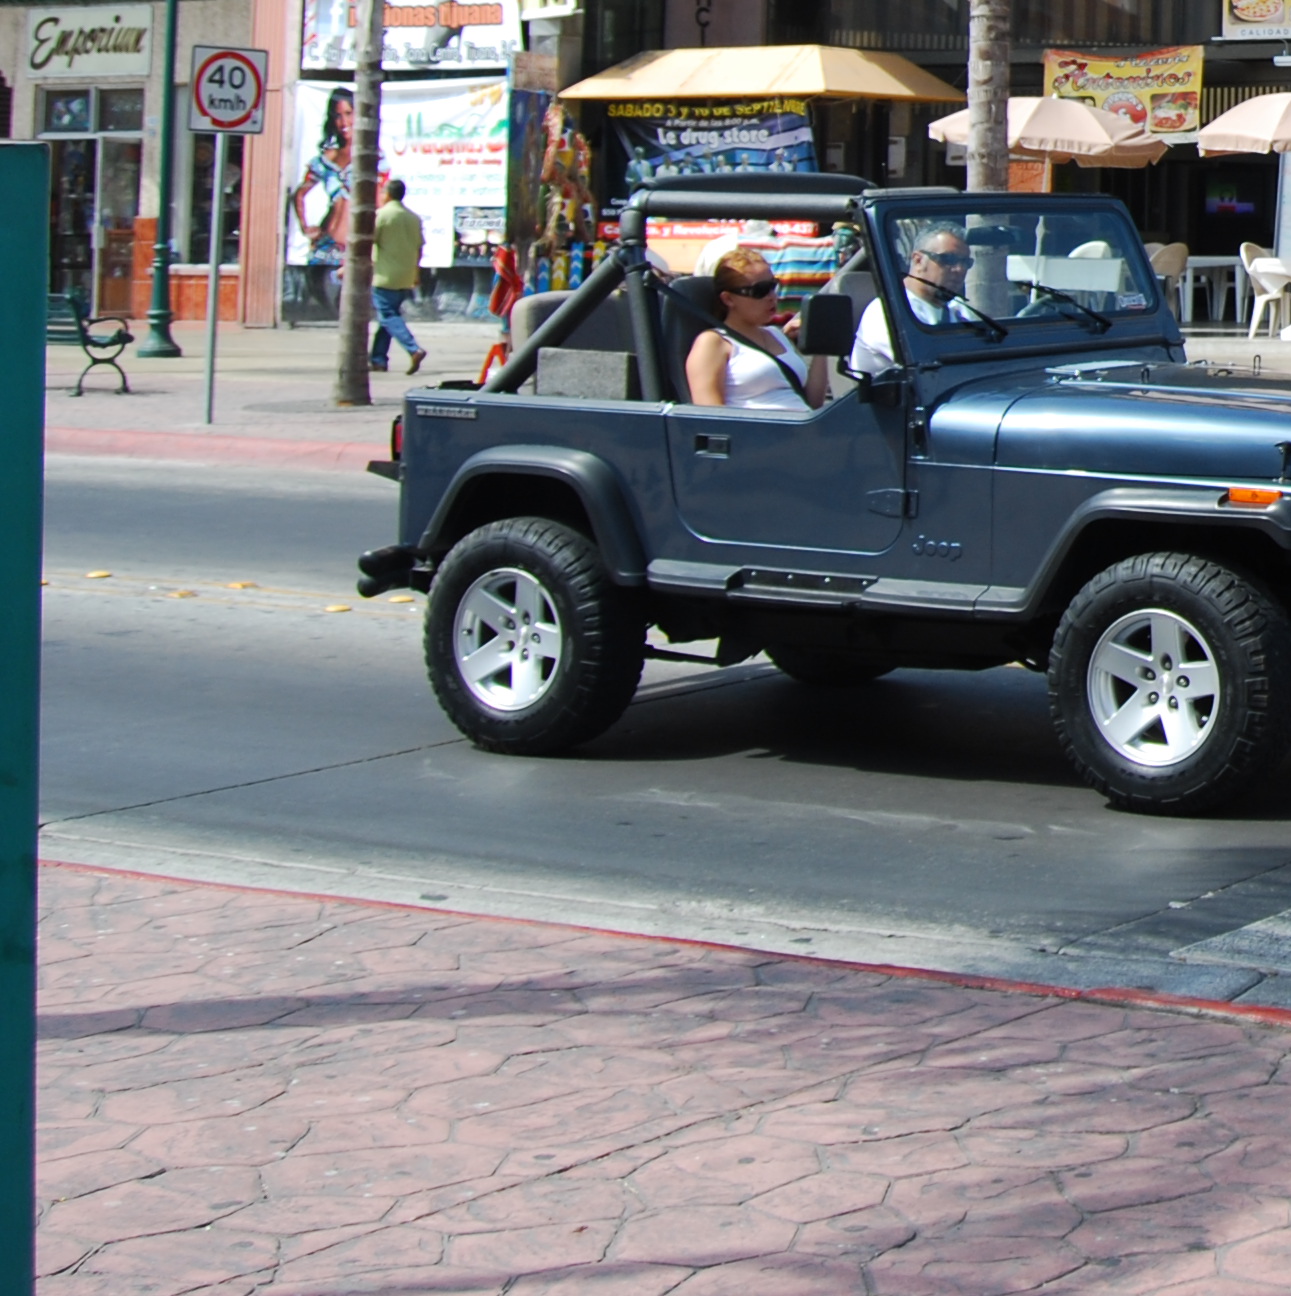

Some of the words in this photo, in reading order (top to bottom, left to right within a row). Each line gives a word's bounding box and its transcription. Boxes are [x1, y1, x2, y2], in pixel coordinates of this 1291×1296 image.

[438, 1, 503, 29] tijuana
[30, 15, 148, 70] Emporium
[206, 64, 247, 90] 40
[1052, 58, 1193, 91] Antoninos
[207, 93, 248, 112] km/h
[607, 103, 664, 117] SABADO
[679, 127, 719, 148] drug
[723, 125, 769, 145] store
